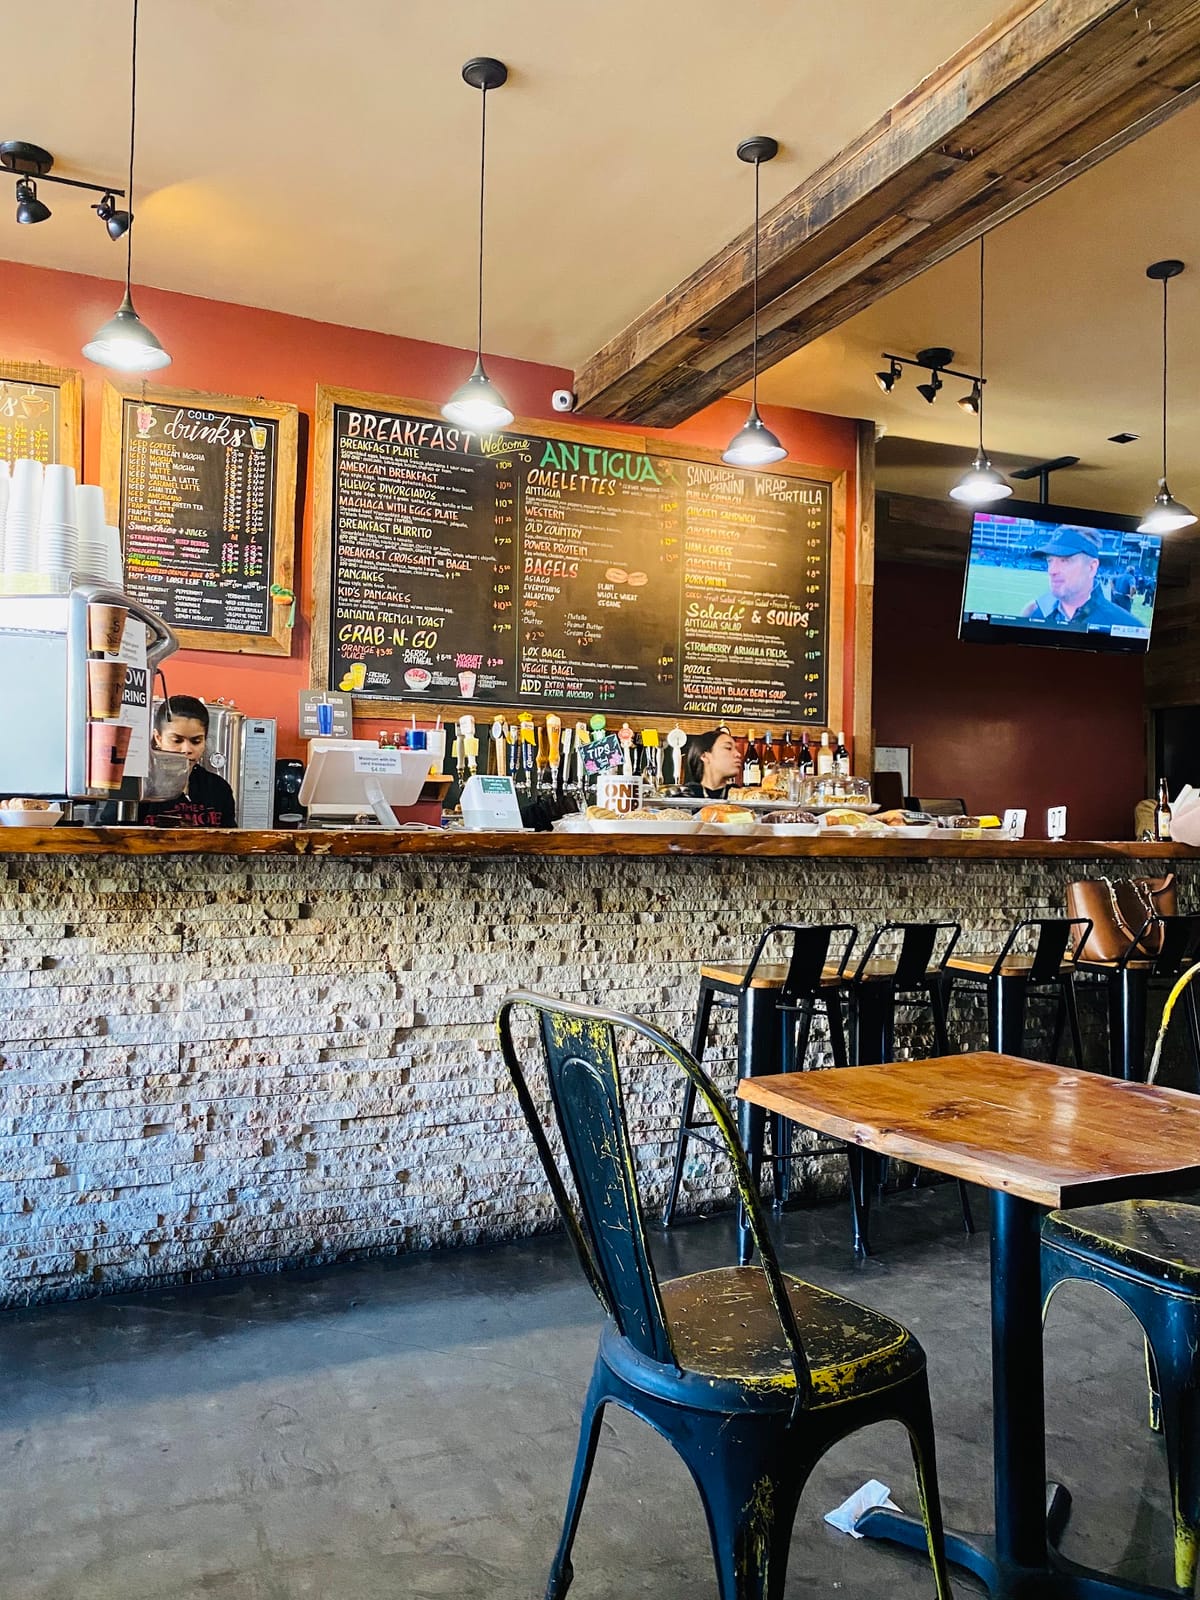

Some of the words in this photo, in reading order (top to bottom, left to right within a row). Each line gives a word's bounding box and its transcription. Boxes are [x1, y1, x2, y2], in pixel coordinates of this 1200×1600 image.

[188, 410, 215, 421] COLD
[164, 409, 245, 447] drinks
[348, 412, 477, 455] BREAKFAST
[480, 433, 530, 454] Welcome
[149, 441, 177, 450] COFFEE
[339, 437, 390, 454] BREAKFAST
[392, 445, 420, 459] PLATE
[129, 446, 147, 454] ICED
[182, 452, 205, 461] MOCHA
[149, 455, 173, 464] MOCHA
[129, 458, 146, 466] ICED
[149, 461, 170, 469] WHITE
[172, 464, 195, 472] MOCHA
[518, 453, 532, 463] TO
[540, 441, 662, 485] ANTIGUA
[149, 467, 171, 475] LATTE
[339, 460, 387, 476] AMERICAN
[389, 466, 438, 483] BREAKFAST
[148, 479, 179, 489] CARAMEL
[180, 484, 201, 492] LATTE
[149, 473, 176, 482] VANILLA
[179, 477, 200, 485] LATTE
[527, 468, 616, 496] OMELETTES
[687, 466, 735, 487] SANDWICH
[754, 477, 787, 497] WRAP
[128, 483, 145, 491] ICED
[339, 478, 377, 492] HUEVOS
[379, 483, 437, 501] DIVORCIADOS
[525, 485, 561, 499] ANTIGUA
[709, 479, 745, 496] PANINI
[769, 489, 823, 505] TORTILLA
[128, 496, 144, 504] ICED
[127, 508, 152, 516] FRAPPE
[154, 505, 176, 513] LATTE
[339, 496, 384, 512] MACHACA
[386, 501, 407, 514] WITH
[409, 504, 432, 517] EGGS
[434, 509, 459, 521] PLATE
[524, 506, 565, 520] WESTERN
[128, 522, 177, 535] Smoothies
[185, 528, 208, 537] JUICES
[339, 517, 391, 533] BREAKFAST
[393, 524, 432, 539] BURRITO
[524, 522, 543, 533] OLD
[544, 525, 582, 539] COUNTRY
[524, 539, 551, 552] POWER
[553, 543, 588, 556] PROTEIN
[338, 545, 387, 561] BREAKFAST
[388, 551, 437, 567] CROISSANT
[445, 558, 472, 571] BAGEL
[524, 557, 579, 578] BAGELS
[338, 567, 385, 583] PANCAKES
[524, 575, 550, 584] ASIAGO
[684, 573, 704, 585] PORK
[337, 587, 361, 599] KID'S
[364, 588, 411, 603] PANCAKES
[523, 584, 561, 594] EVERYTHING
[337, 608, 375, 622] BANANA
[377, 612, 414, 625] FRENCH
[416, 615, 445, 629] TOAST
[523, 616, 543, 626] Butter
[686, 603, 745, 621] Salads
[751, 610, 762, 624] &
[766, 610, 810, 628] SOUPS
[684, 618, 718, 629] ANTIGUA
[720, 621, 742, 632] SALAD
[338, 624, 385, 646] GRAB
[412, 630, 438, 649] GO
[341, 643, 376, 654] ORANGE
[341, 650, 366, 660] JUICE
[404, 649, 429, 658] BERRY
[456, 653, 483, 661] YOGURT
[522, 647, 540, 657] LOX
[541, 648, 567, 659] BAGEL
[684, 641, 731, 654] STRAWBERRY
[734, 644, 765, 657] ARUGULA
[403, 655, 433, 666] OATMEAL
[521, 663, 549, 675] VEGGIE
[551, 665, 575, 676] BAGEL
[683, 664, 712, 675] POZOLE
[124, 666, 146, 688] OW
[520, 679, 542, 692] ADD
[544, 680, 565, 689] EXTRA
[683, 683, 726, 696] VEGETARIAN
[727, 686, 750, 697] BLACK
[749, 688, 768, 698] BEAN
[768, 689, 787, 700] SOUP
[543, 689, 564, 698] EXTRA
[566, 690, 594, 699] AVOCADO
[683, 701, 717, 713] CHICKEN
[721, 704, 742, 714] SOUP
[111, 746, 125, 764] L
[587, 743, 611, 759] TIPS
[605, 783, 640, 799] ONE
